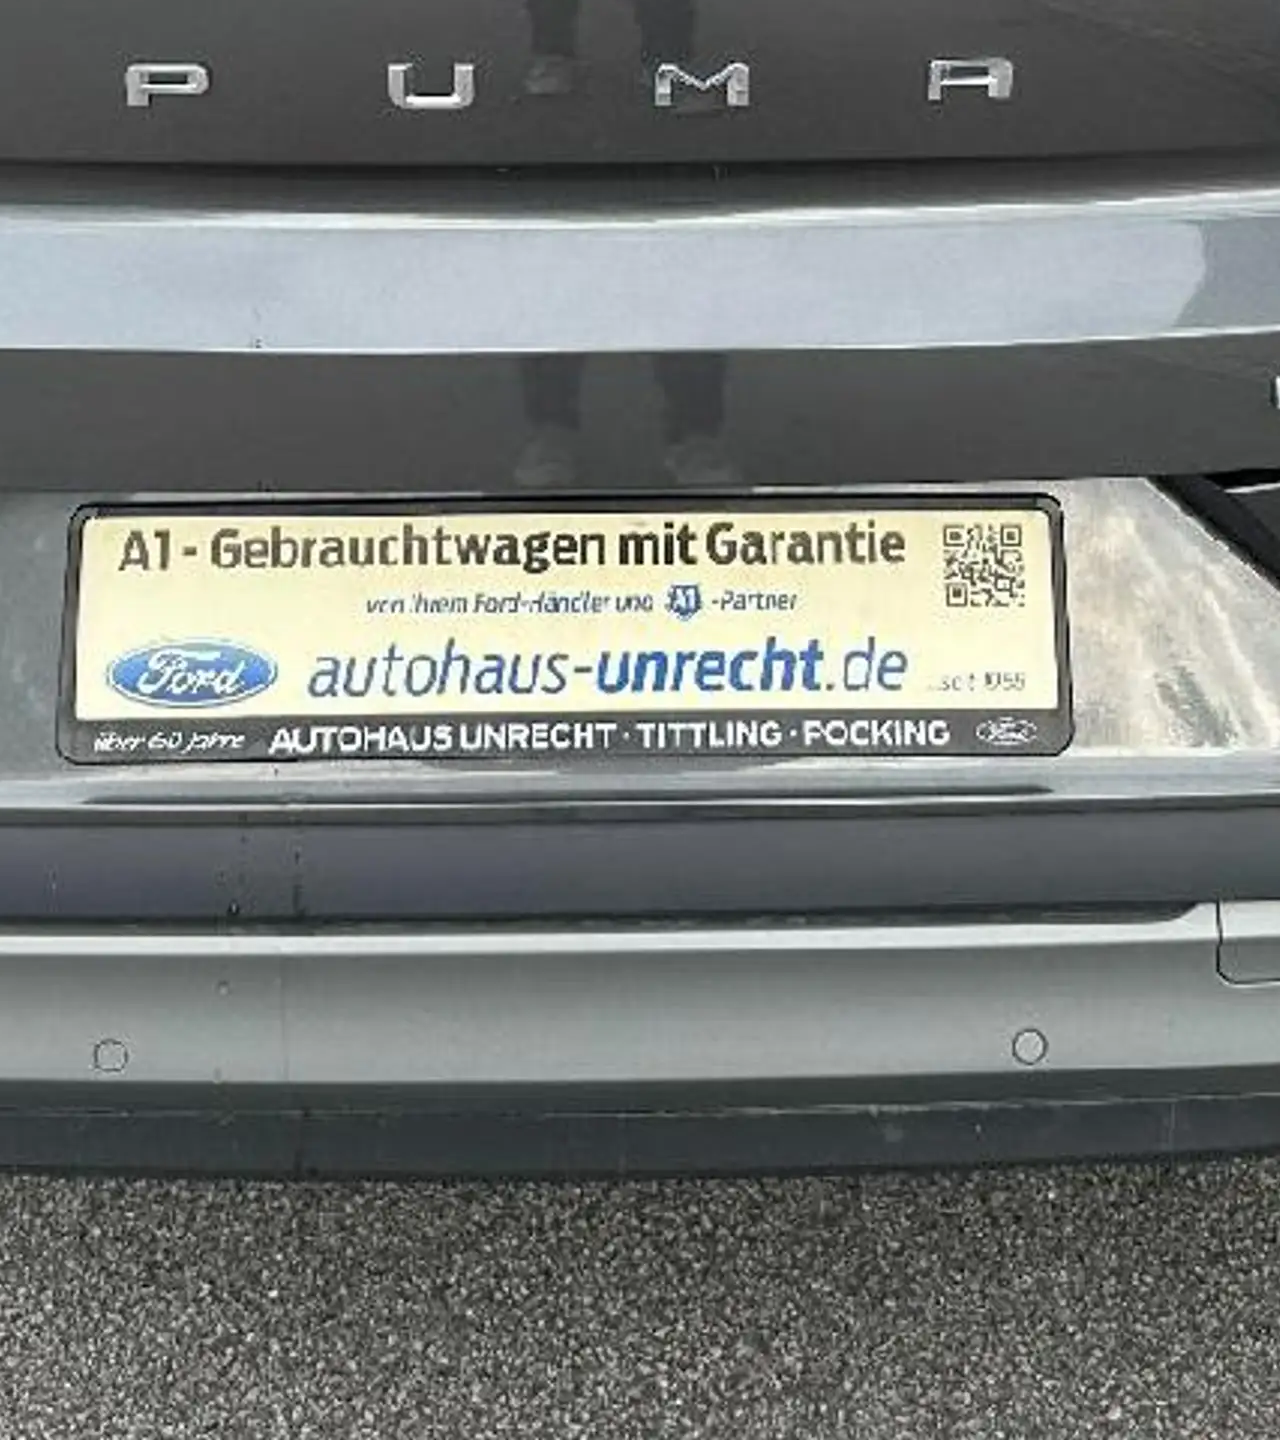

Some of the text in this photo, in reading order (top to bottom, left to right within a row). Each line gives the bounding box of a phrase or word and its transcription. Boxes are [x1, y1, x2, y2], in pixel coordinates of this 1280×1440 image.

[124, 56, 1015, 110] PUMA
[618, 521, 698, 566] mit
[706, 520, 906, 565] Garantie
[137, 648, 246, 695] Ford
[307, 635, 909, 697] autohaus-unrecht.de
[268, 724, 453, 754] AUTOHAUS
[458, 722, 617, 751] UNRECHT
[635, 720, 783, 749] TITTLING
